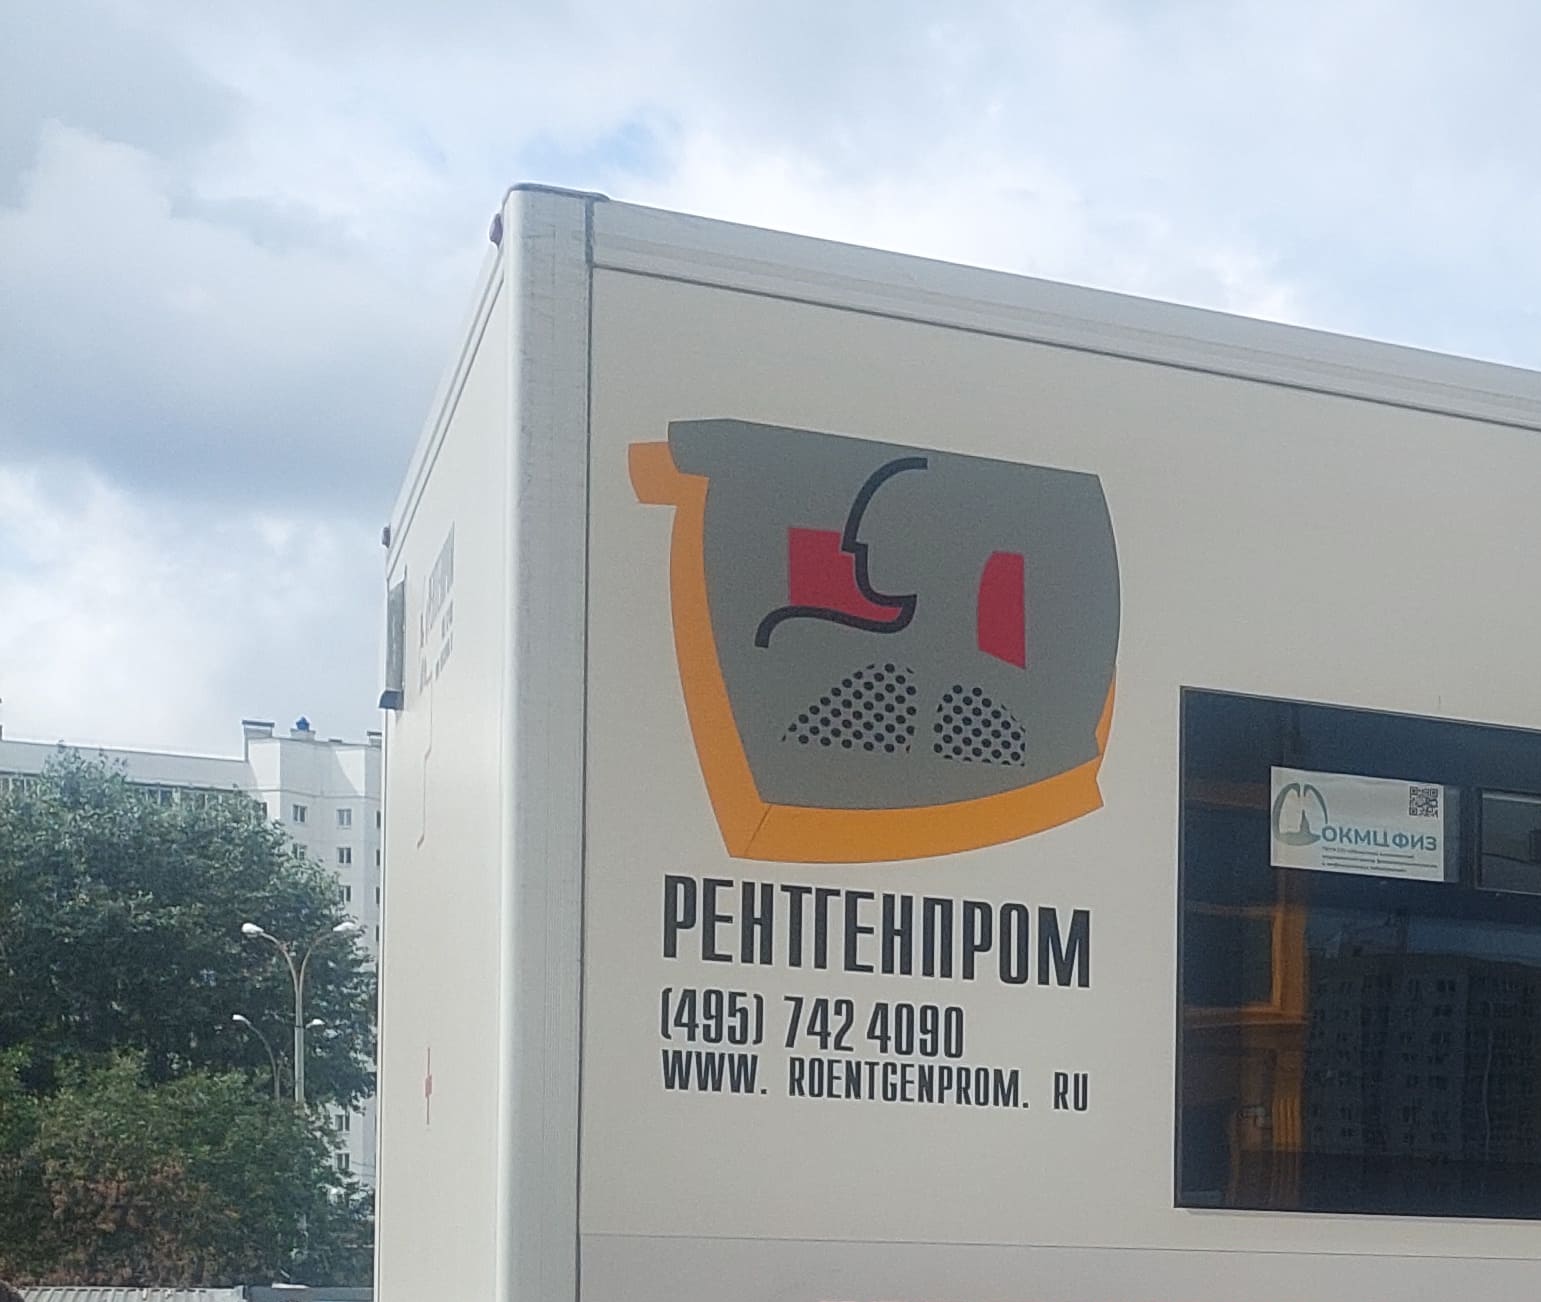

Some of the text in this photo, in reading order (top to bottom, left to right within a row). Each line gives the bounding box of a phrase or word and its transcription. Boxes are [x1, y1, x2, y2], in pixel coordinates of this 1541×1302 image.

[663, 874, 1090, 988] РЕНТГЕНПРОМ
[661, 987, 964, 1059] (495) 742 4090
[662, 1049, 767, 1095] WWW.
[1054, 1072, 1089, 1111] RU
